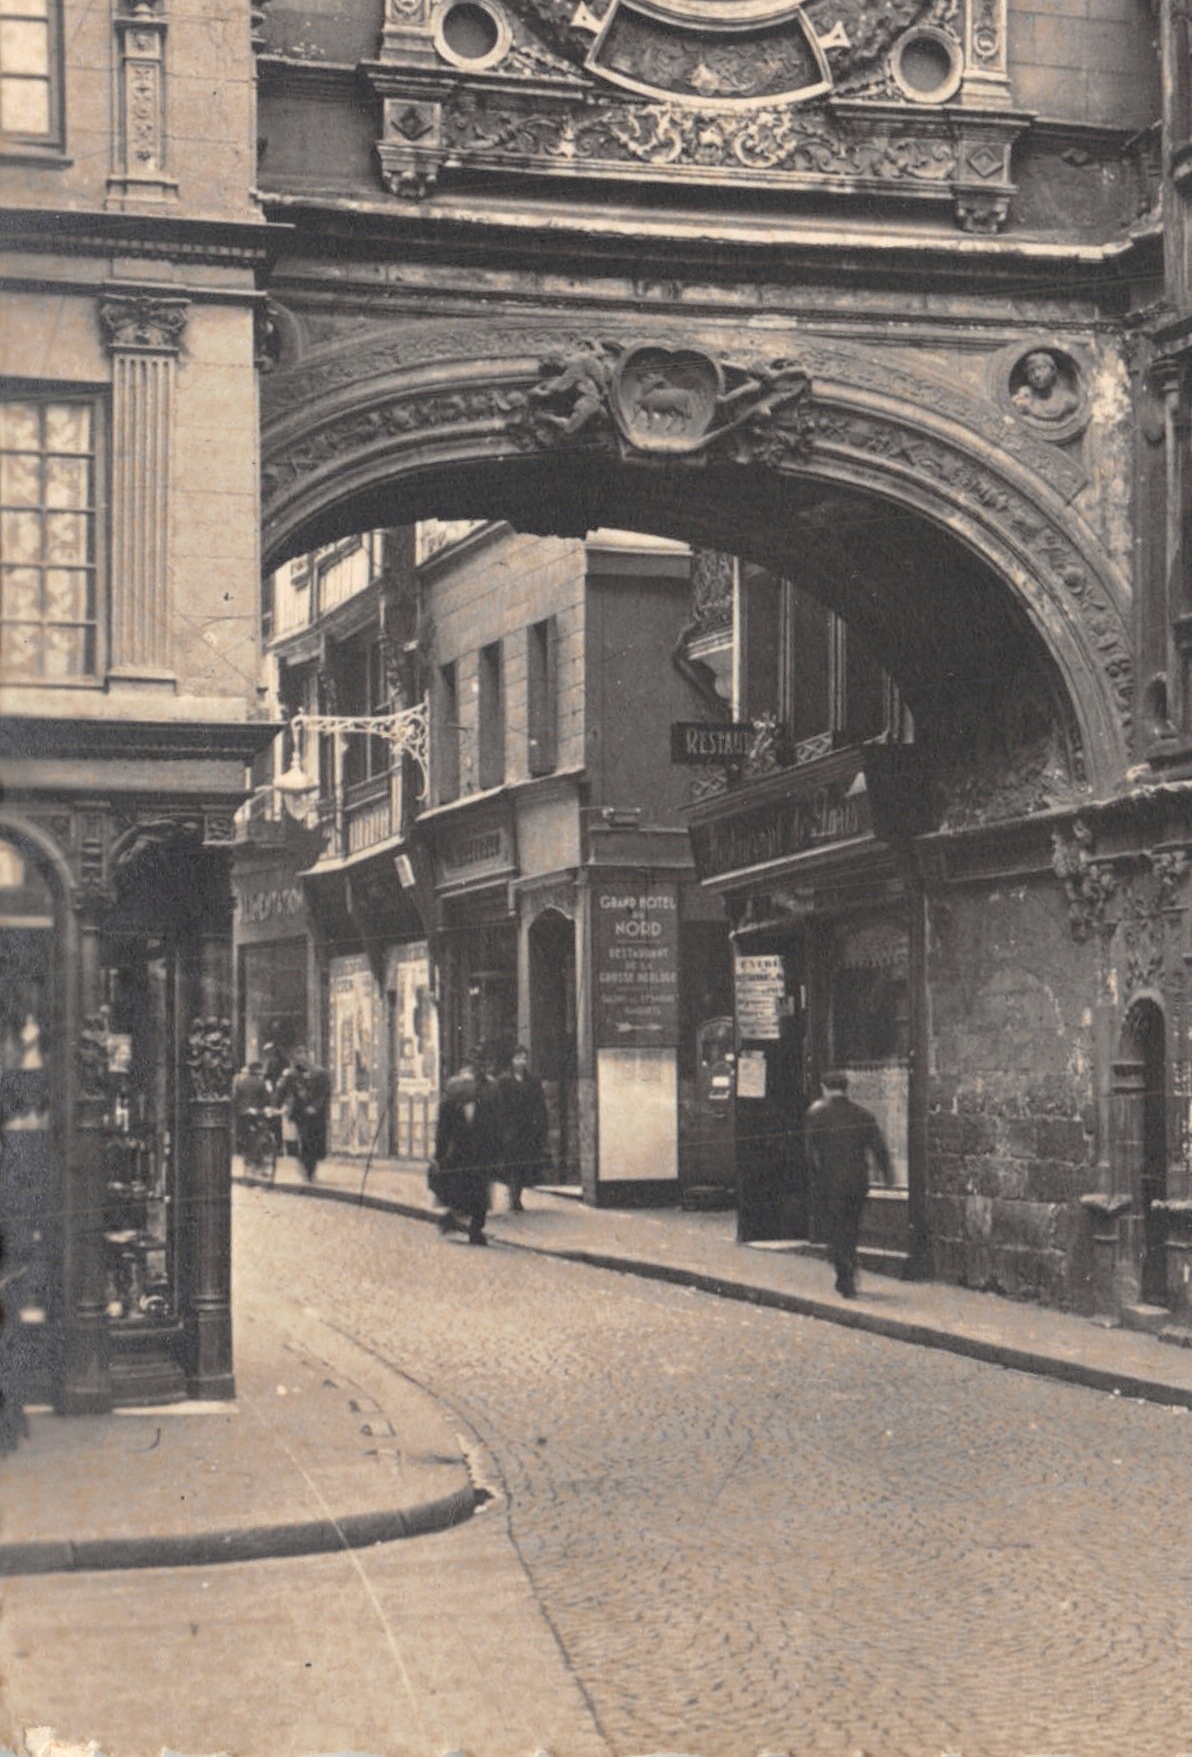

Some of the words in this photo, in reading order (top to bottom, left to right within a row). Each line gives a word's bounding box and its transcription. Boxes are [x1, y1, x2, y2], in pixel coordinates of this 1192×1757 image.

[600, 896, 637, 909] GRAND
[639, 896, 676, 909] HOTEL
[615, 921, 662, 937] NORD
